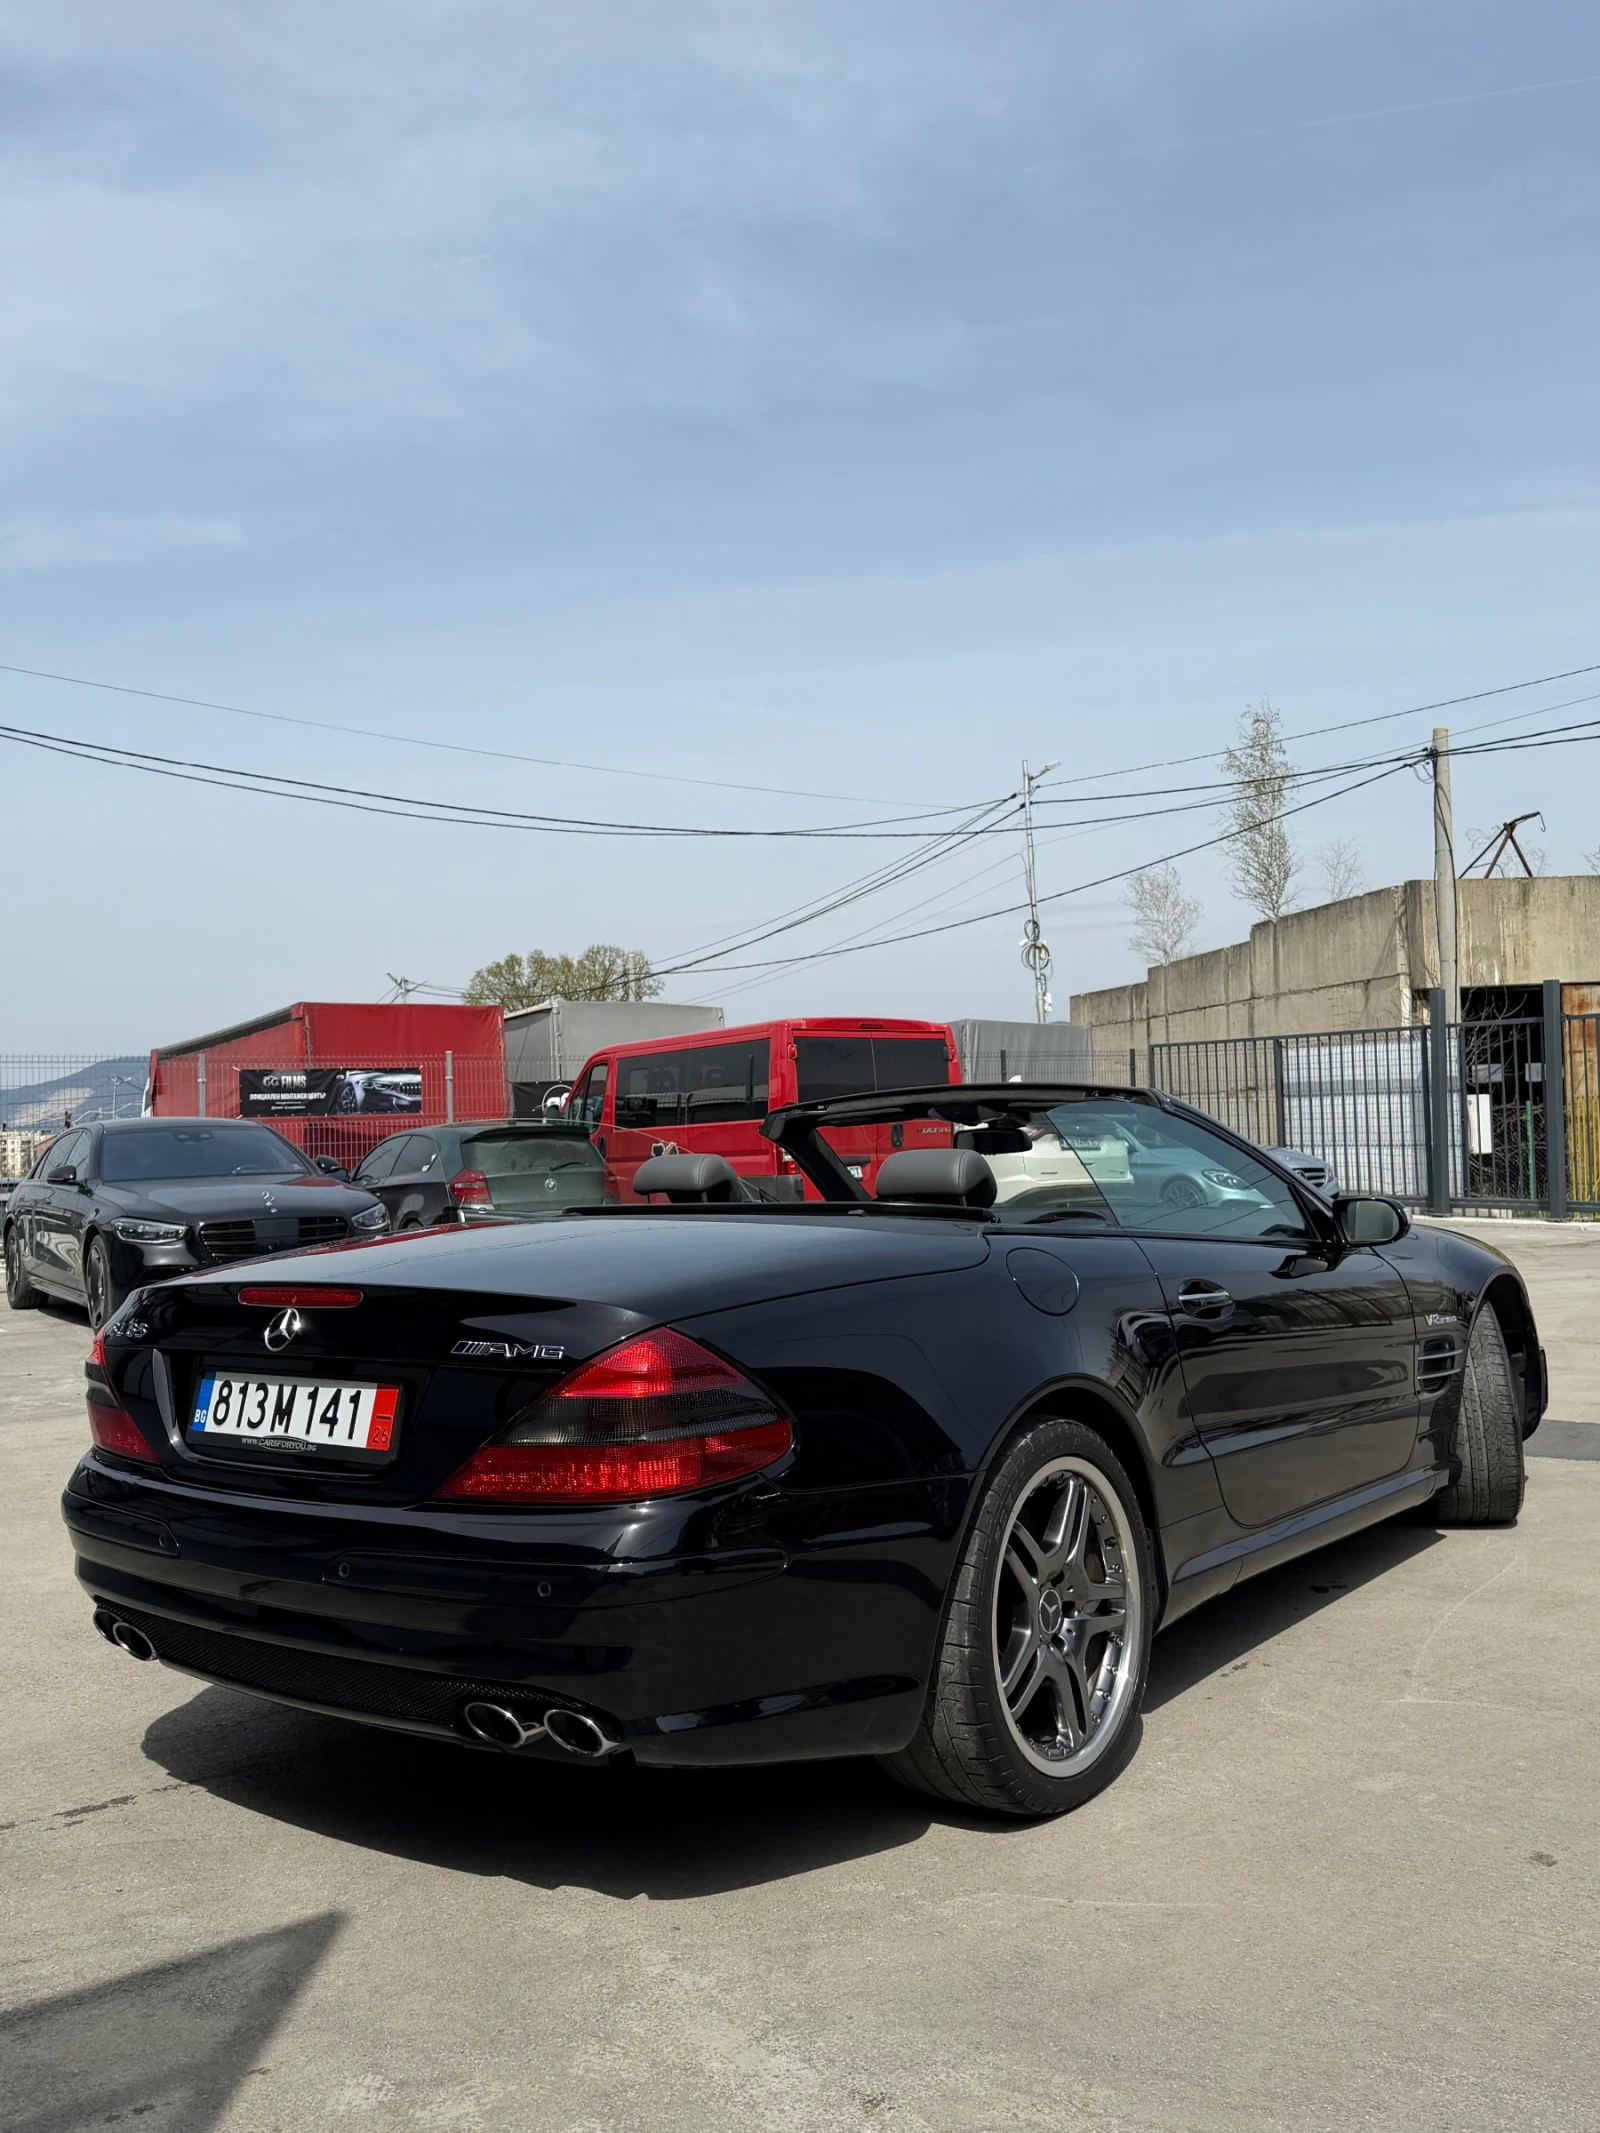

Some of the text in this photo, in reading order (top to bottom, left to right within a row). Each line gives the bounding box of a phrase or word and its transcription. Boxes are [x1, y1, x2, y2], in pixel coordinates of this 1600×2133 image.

[281, 1075, 307, 1089] FILMS
[484, 1341, 565, 1359] AMG
[194, 1408, 208, 1424] BG
[372, 1426, 388, 1445] 26
